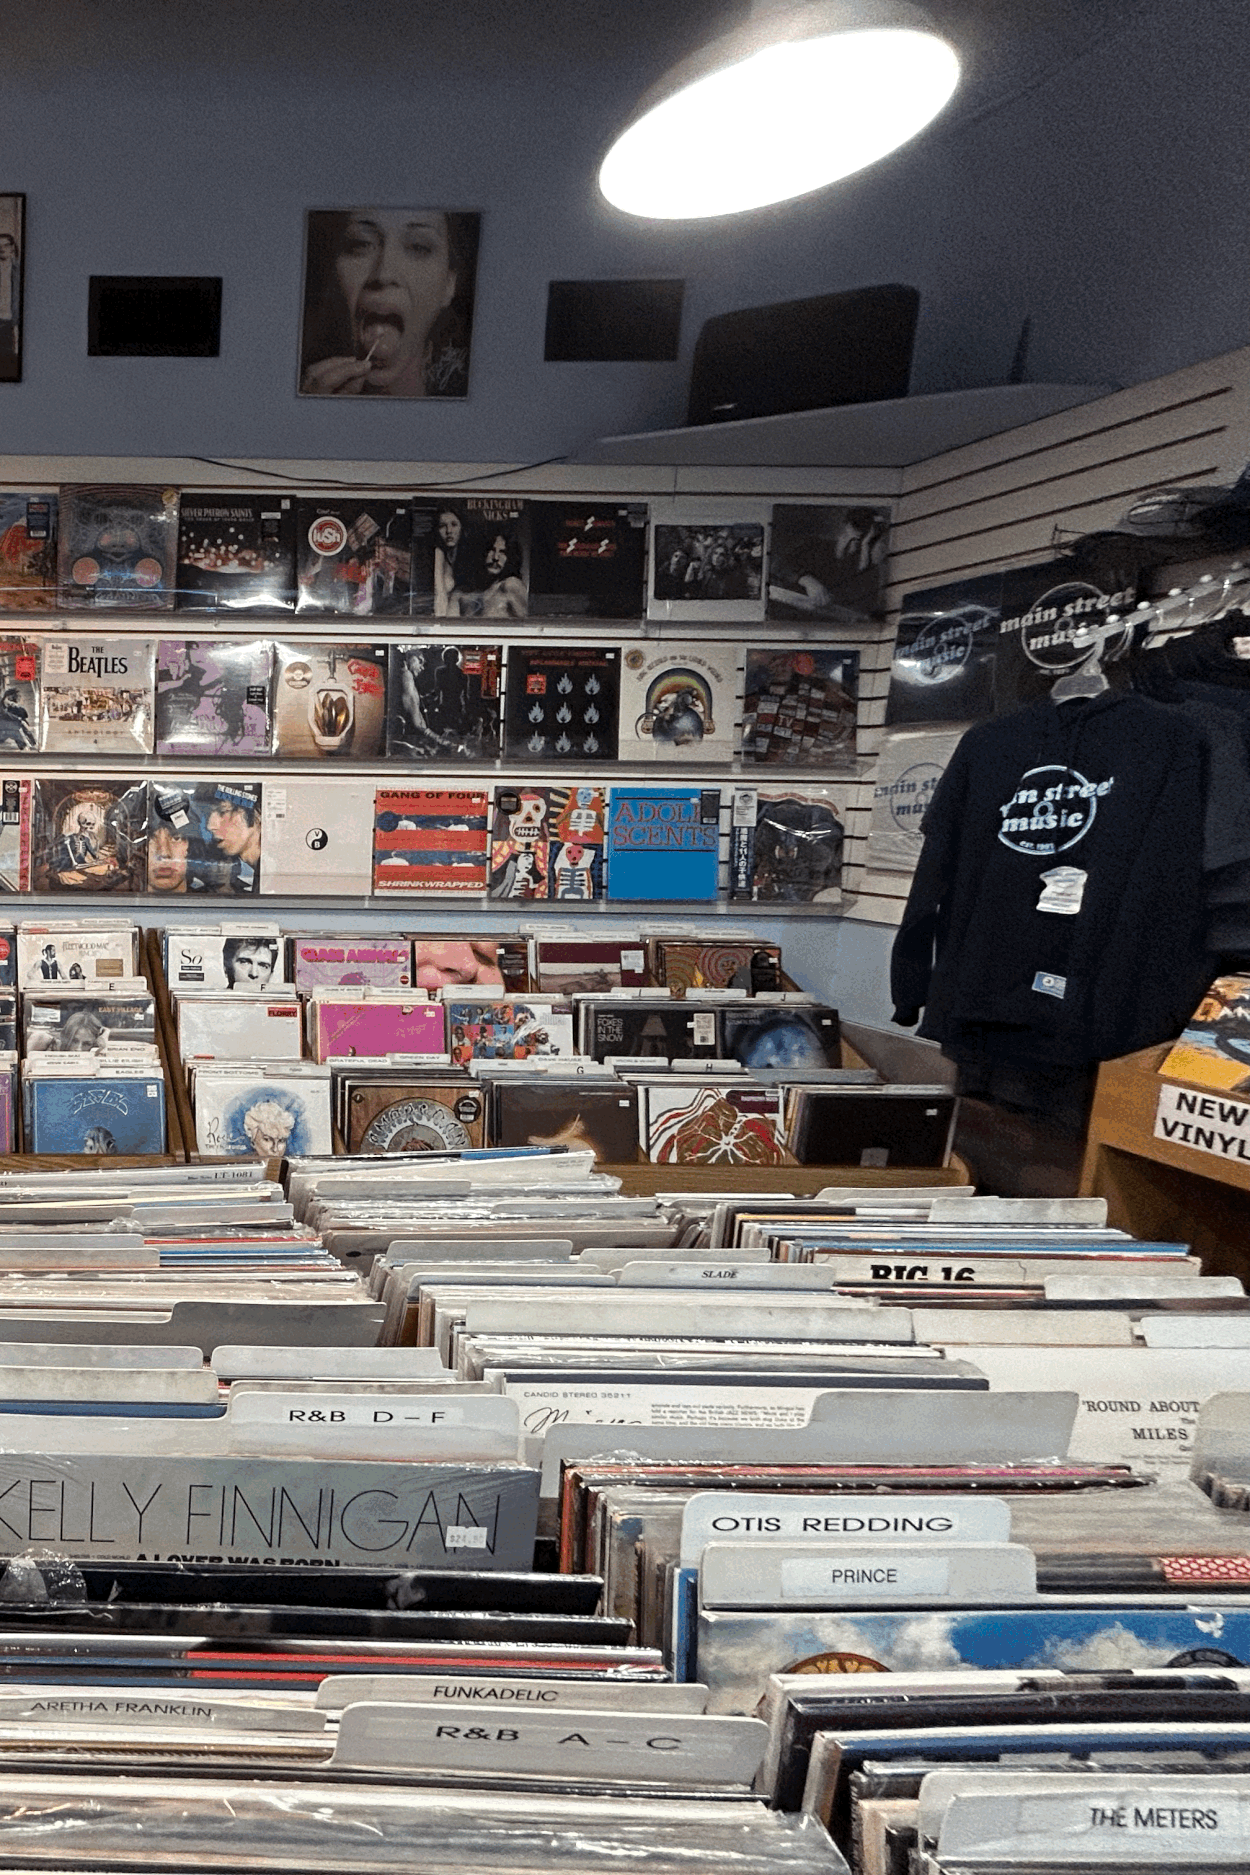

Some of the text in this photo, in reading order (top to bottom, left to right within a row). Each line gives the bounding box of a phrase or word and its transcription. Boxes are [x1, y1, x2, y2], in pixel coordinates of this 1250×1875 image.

[467, 499, 524, 510] BUCKINGHAM
[483, 510, 508, 520] NICKS
[999, 587, 1137, 633] main street
[92, 646, 104, 654] THE
[68, 647, 129, 678] BEATLES
[380, 791, 485, 800] GANG OF FOUR
[1001, 808, 1084, 832] music
[613, 825, 717, 847] SCENTS
[378, 880, 484, 889] SHRINKWRAPPED
[180, 949, 203, 965] So
[108, 982, 116, 991] E
[260, 983, 266, 991] F
[597, 1018, 623, 1027] FOXES
[597, 1026, 623, 1034] IN THE
[597, 1034, 623, 1042] SNOW
[576, 1066, 584, 1075] G
[706, 1064, 713, 1072] H
[1176, 1092, 1249, 1127] NEW
[1161, 1116, 1250, 1161] VINYL
[701, 1270, 739, 1280] SLADE
[562, 1391, 598, 1399] STEREO
[1150, 1401, 1200, 1413] ABOUT
[288, 1410, 446, 1424] R&B D F
[1131, 1428, 1189, 1440] MILES
[187, 1483, 502, 1556] FINNIGAN
[712, 1517, 954, 1532] OTIS REDDING
[831, 1568, 898, 1584] PRINCE
[433, 1685, 559, 1702] FUNKADELIC
[31, 1700, 213, 1718] ARETHA FRANKLIN
[435, 1725, 683, 1751] R&B A C
[1090, 1807, 1219, 1830] THE METERS
